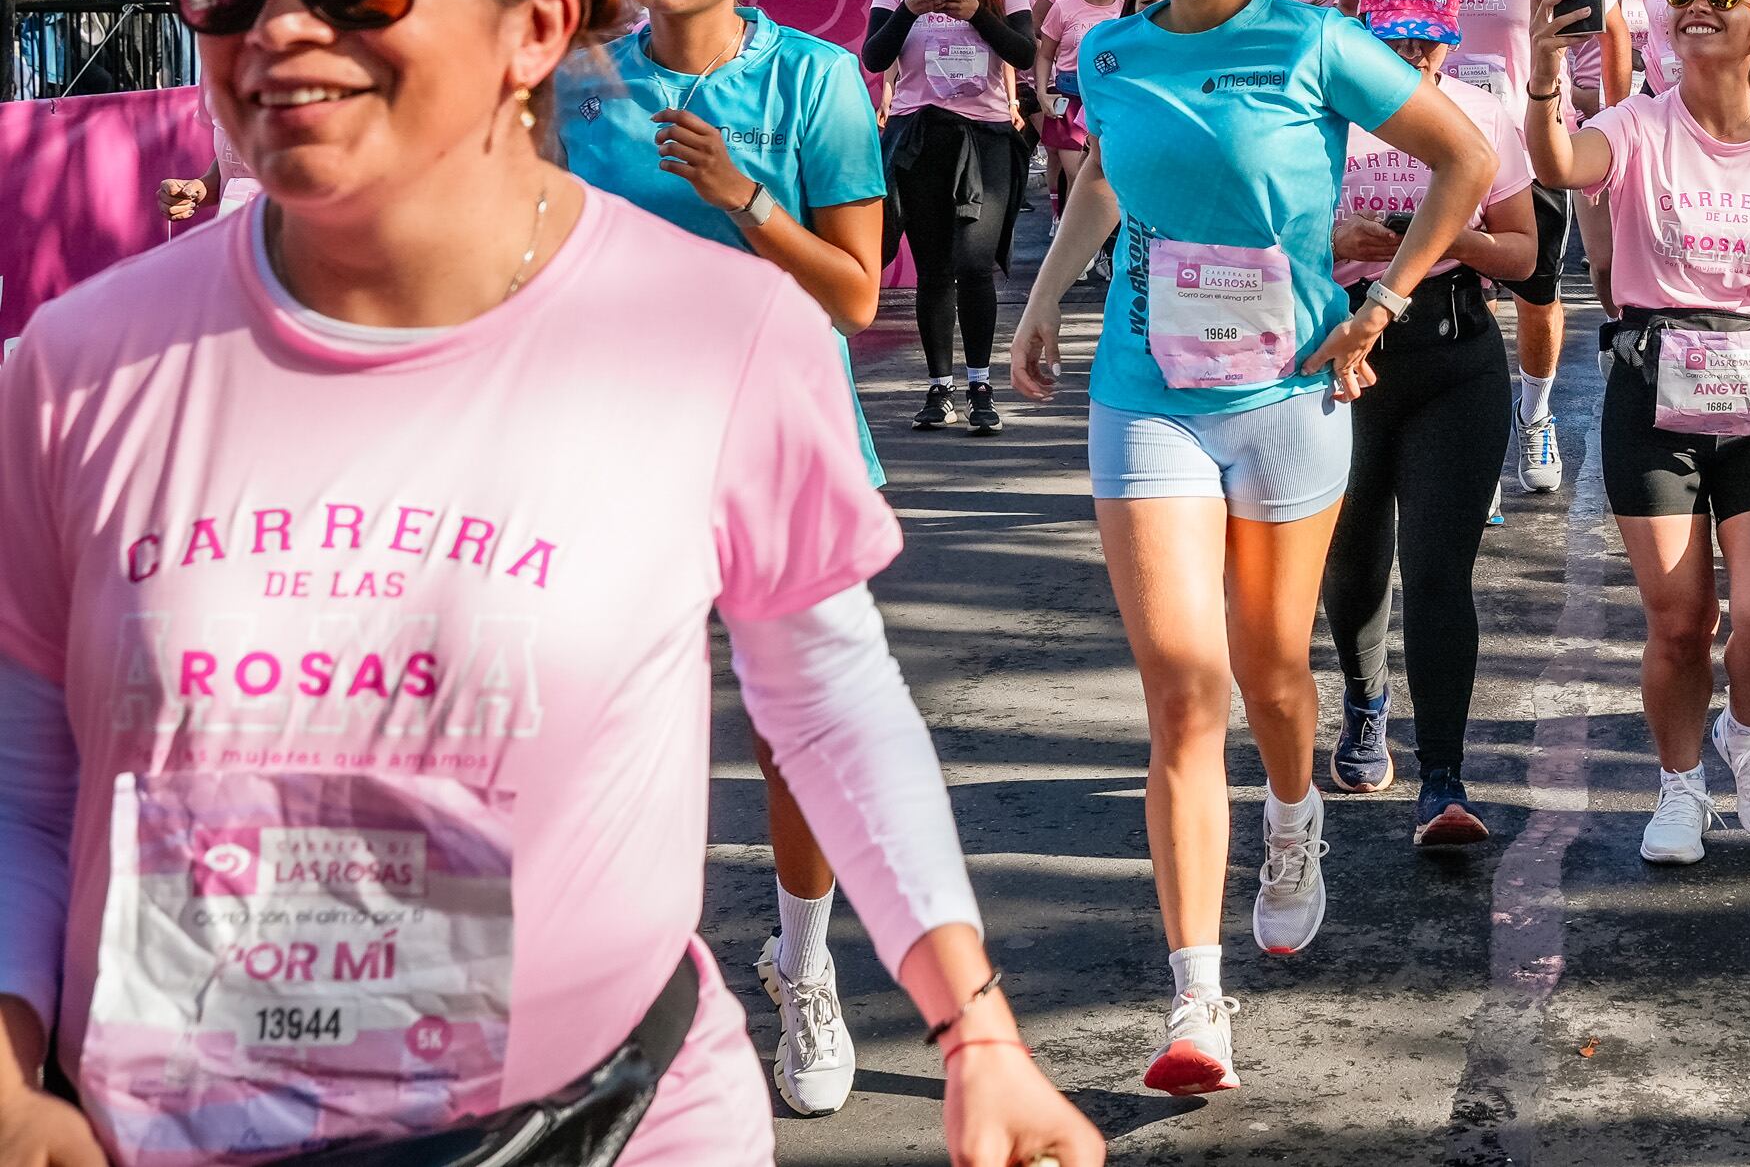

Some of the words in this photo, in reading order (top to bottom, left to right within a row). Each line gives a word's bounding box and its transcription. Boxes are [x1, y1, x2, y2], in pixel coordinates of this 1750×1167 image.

[927, 15, 959, 23] ROS
[1217, 70, 1285, 89] Medipiel
[1347, 150, 1431, 173] ARRE
[1374, 172, 1388, 182] DE
[1393, 172, 1415, 182] LAS
[1354, 196, 1422, 212] ROSA
[1705, 211, 1720, 222] DE
[1725, 213, 1749, 224] LAS
[1205, 269, 1243, 278] CARRERA
[1204, 277, 1223, 287] LAS
[1224, 279, 1258, 289] ROSAS
[1177, 291, 1199, 299] Corro
[1222, 294, 1242, 302] alma
[1242, 295, 1256, 303] por
[1204, 327, 1238, 340] 19648
[1710, 359, 1725, 367] LAS
[1693, 382, 1748, 395] ANGYE
[1706, 402, 1733, 412] 16864
[126, 502, 558, 590] CARRERA
[263, 570, 313, 599] DE
[328, 571, 406, 599] LAS
[178, 650, 438, 699] ROSAS
[275, 861, 321, 884] LAS
[327, 861, 413, 885] ROSAS
[333, 928, 400, 981] MÍ
[255, 1007, 342, 1040] 13944
[415, 1027, 444, 1050] 5K
